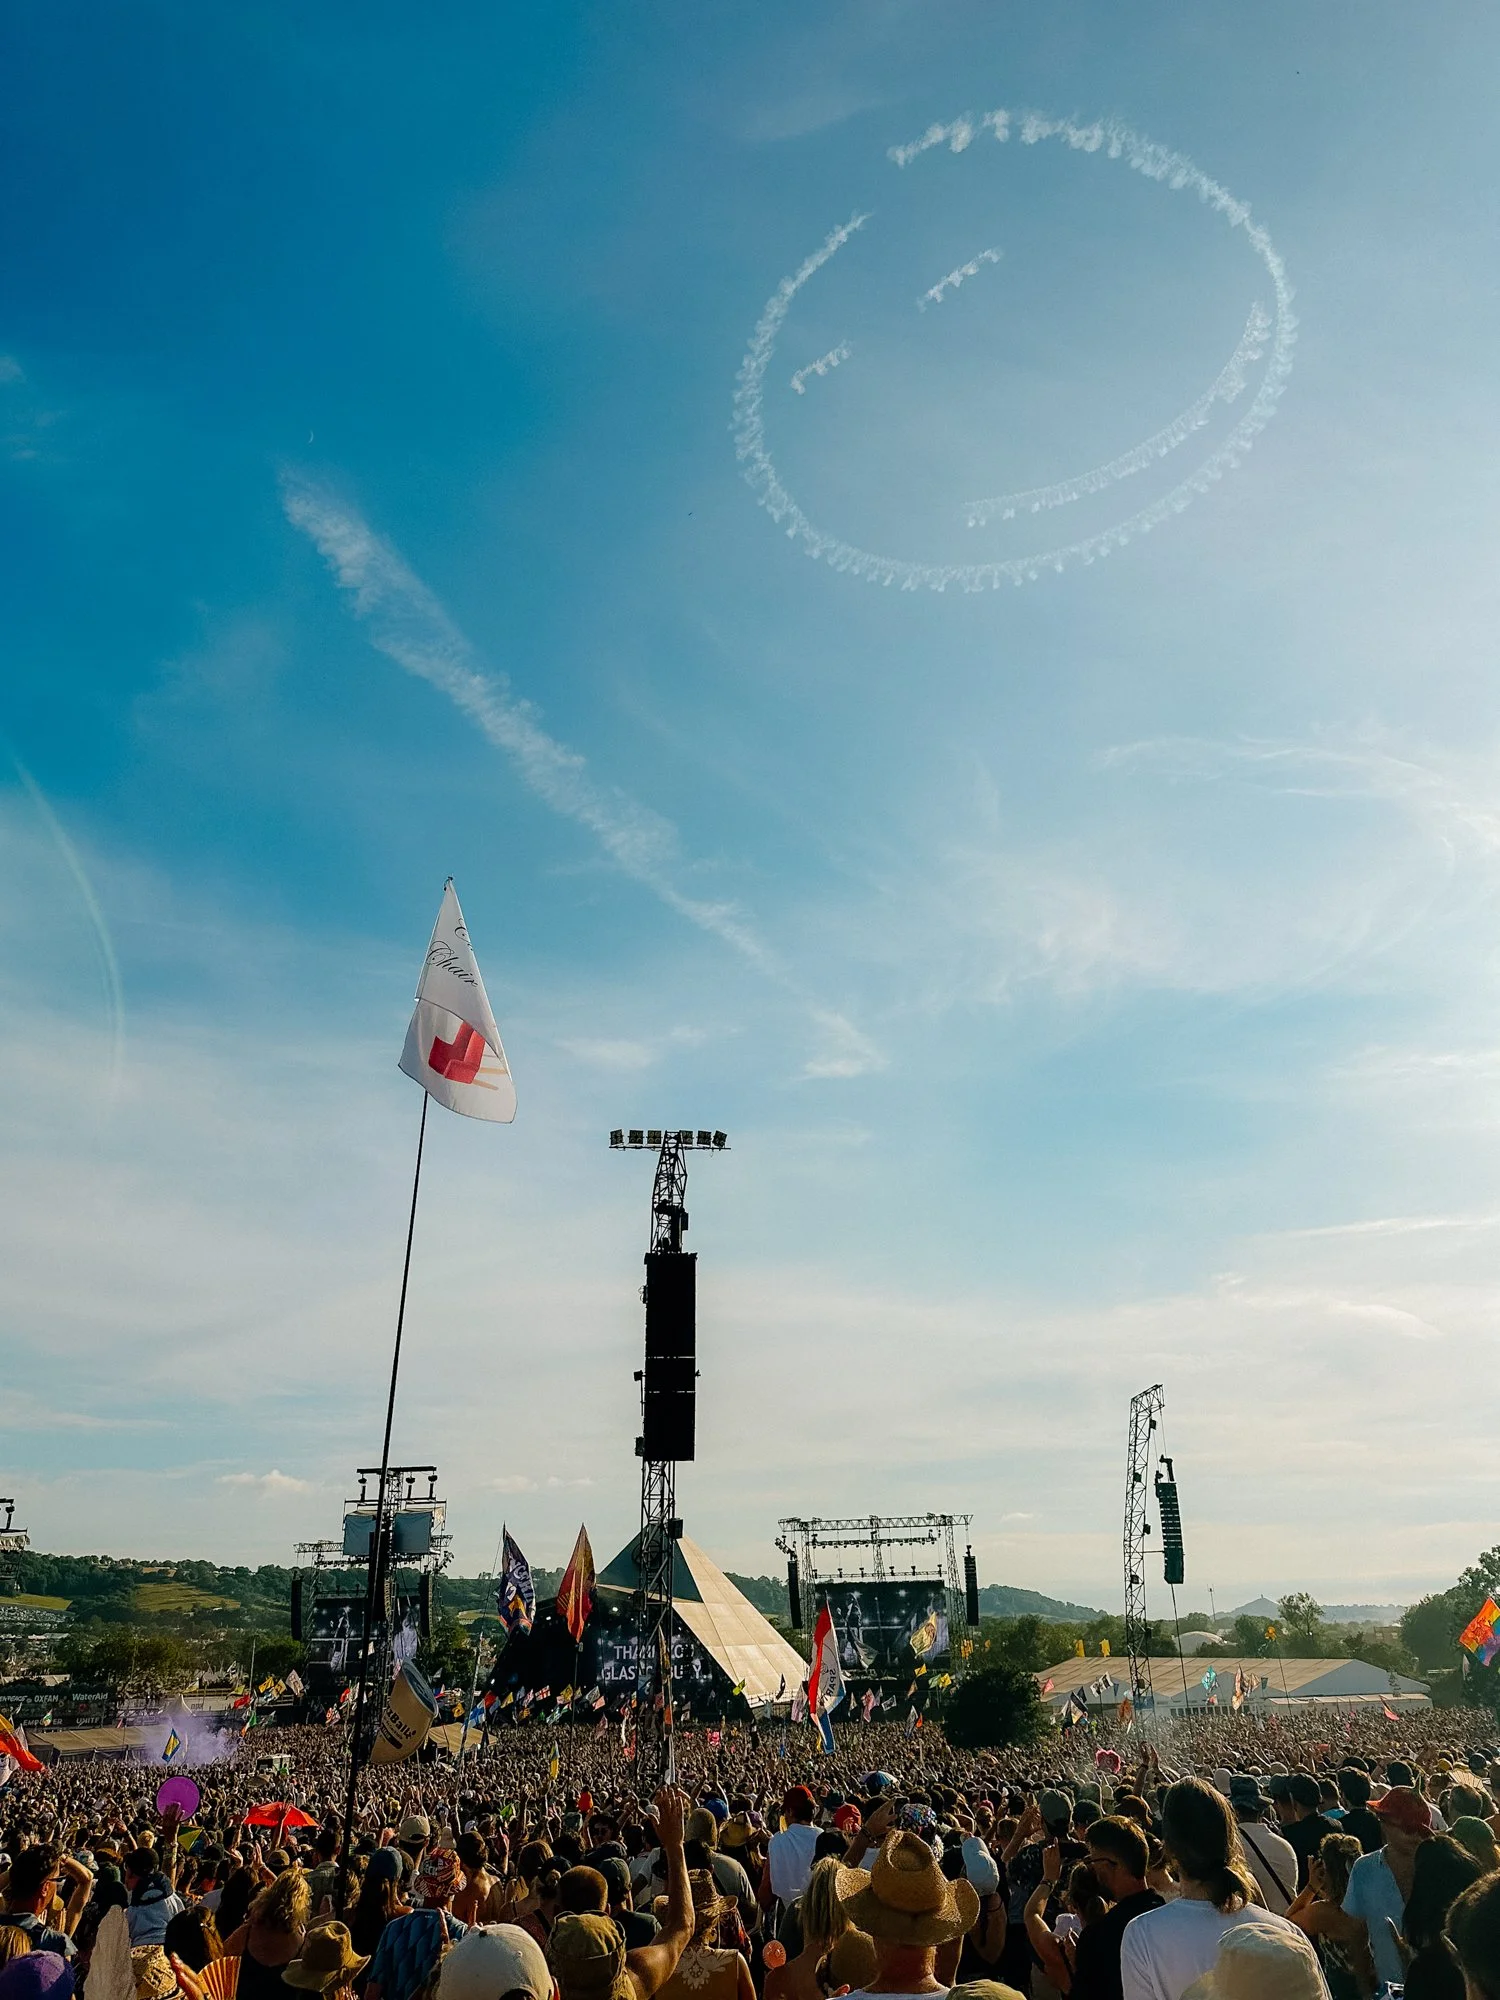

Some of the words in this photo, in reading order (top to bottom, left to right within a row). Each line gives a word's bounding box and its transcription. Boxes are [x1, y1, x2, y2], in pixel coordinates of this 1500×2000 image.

[426, 940, 478, 987] Chair
[34, 1694, 59, 1703] OXFAM
[72, 1692, 109, 1701] WaterAid
[23, 1718, 63, 1727] EMPOER
